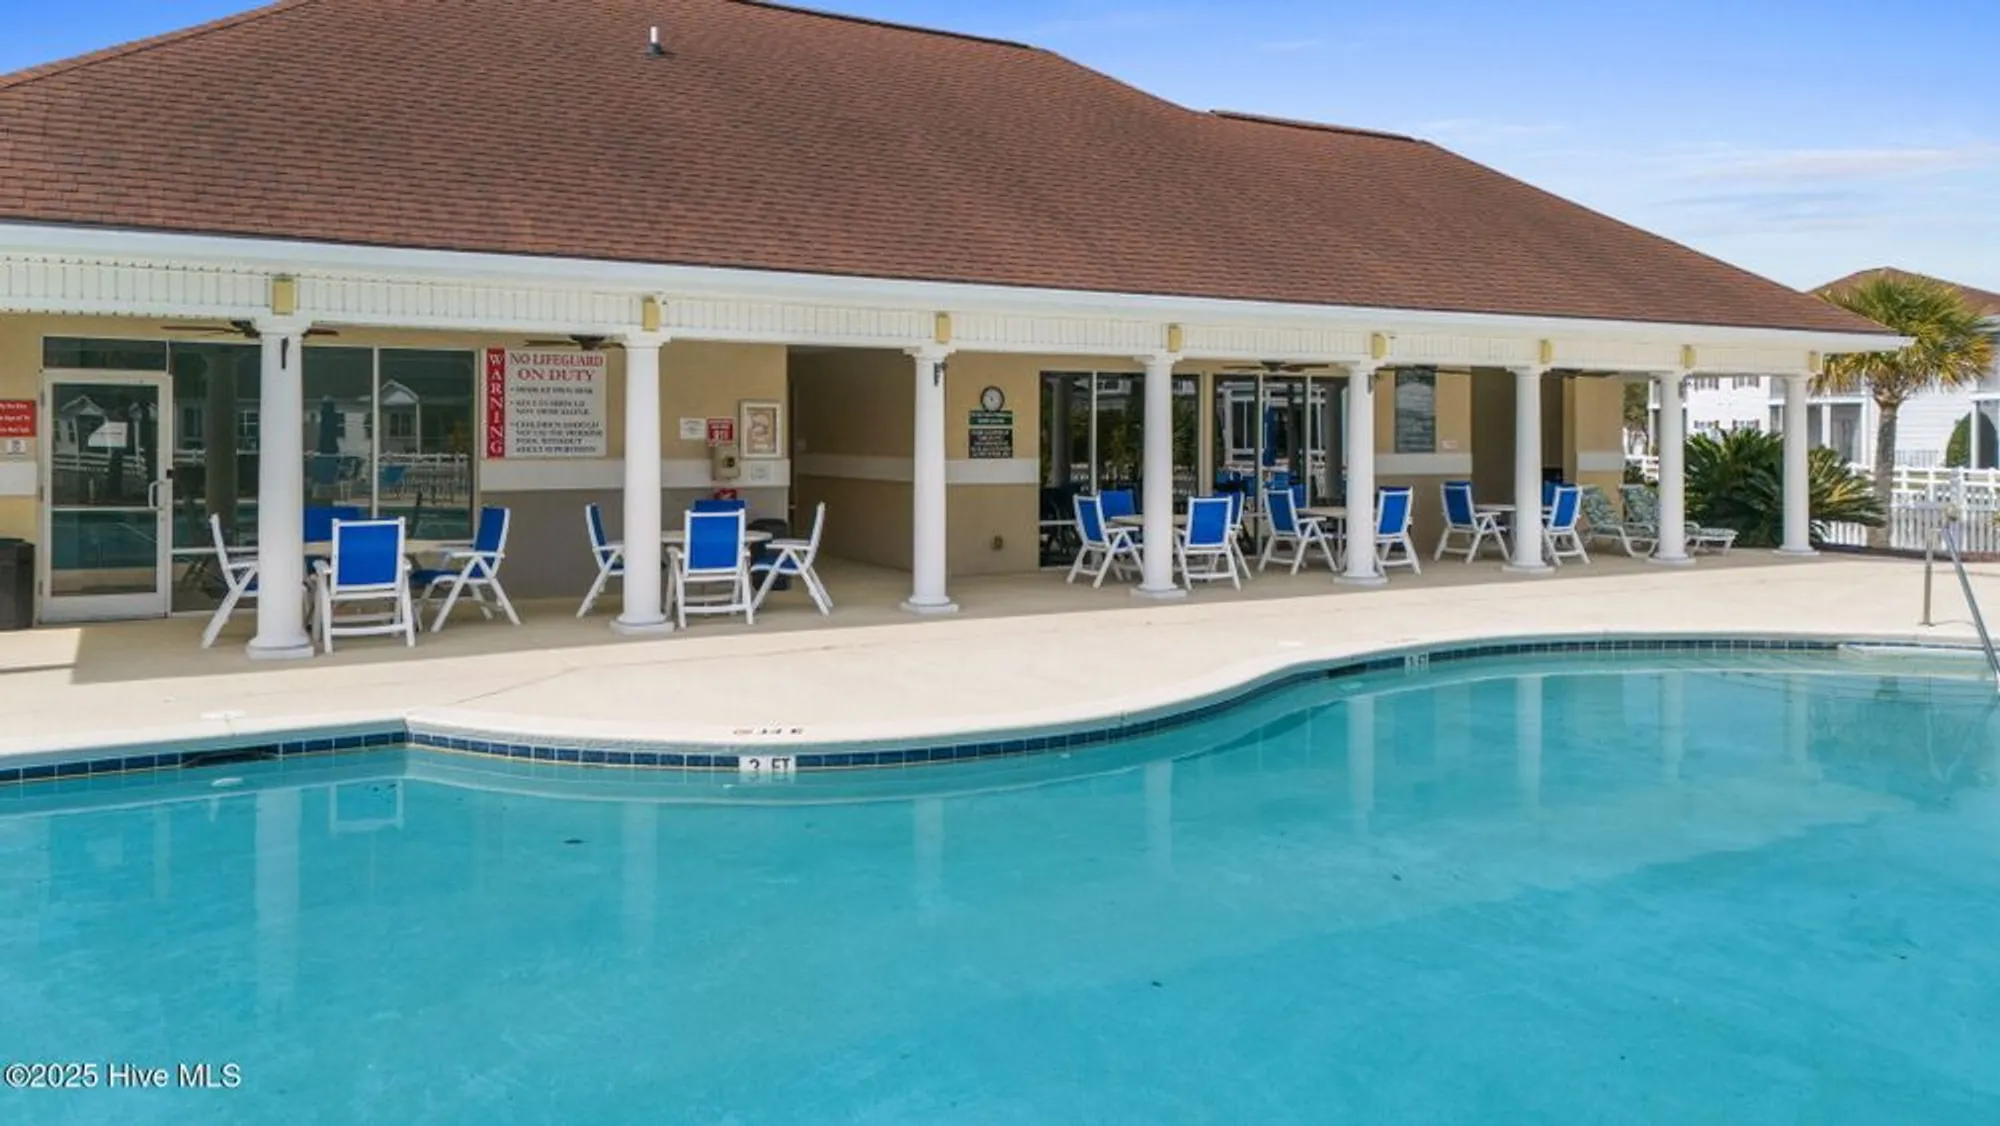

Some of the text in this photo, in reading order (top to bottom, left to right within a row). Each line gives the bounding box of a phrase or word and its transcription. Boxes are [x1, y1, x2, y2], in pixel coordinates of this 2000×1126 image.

[510, 353, 603, 367] NO LIFEGUARD
[518, 369, 594, 381] ON DUTY
[489, 352, 504, 454] WARNING
